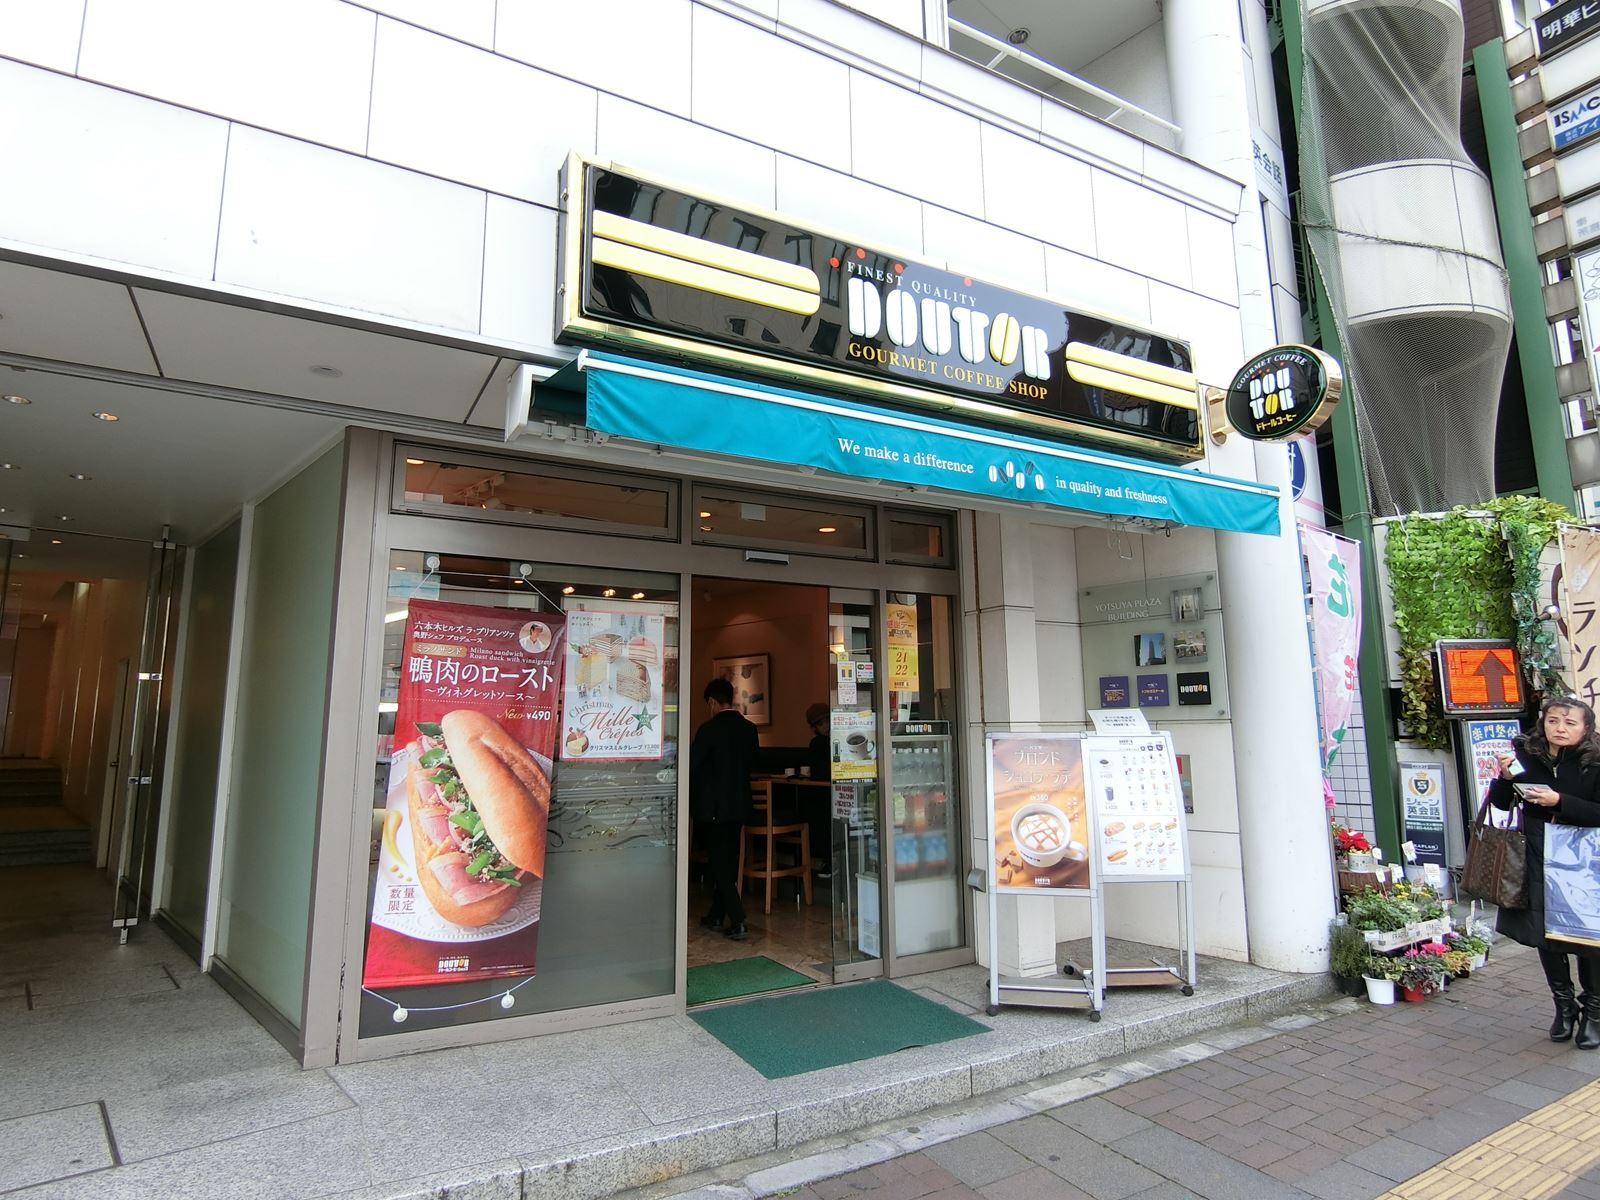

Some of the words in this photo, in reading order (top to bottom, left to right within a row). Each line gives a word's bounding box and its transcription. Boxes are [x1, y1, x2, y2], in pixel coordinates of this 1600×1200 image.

[848, 261, 904, 287] FINEST
[911, 280, 977, 307] QUALITY
[848, 277, 1051, 382] DOUTOR
[849, 342, 938, 376] GOURMET
[943, 364, 1005, 391] COFFEE
[1009, 379, 1048, 400] SHOP
[1236, 357, 1272, 390] GOURMET
[1273, 353, 1308, 366] COFFEE
[1255, 413, 1297, 432] ドトールコーヒー
[838, 437, 861, 456] We
[864, 446, 899, 462] make
[903, 452, 911, 464] a
[913, 452, 974, 475] difference
[1055, 475, 1067, 489] in
[1069, 480, 1102, 498] quality
[1104, 486, 1122, 500] and
[1125, 488, 1168, 505] freshness
[1095, 600, 1134, 613] YOTSUYA
[1134, 597, 1162, 609] PLAZA
[1107, 609, 1150, 621] BUILDING
[414, 620, 464, 633] 六本木ヒルズ
[446, 633, 483, 644] プロデュース
[469, 652, 489, 661] Roast
[489, 654, 504, 662] duck
[470, 646, 494, 655] Milano
[494, 648, 524, 657] sandwich
[896, 651, 907, 663] 21
[1450, 651, 1468, 675] 4F
[408, 655, 554, 692] 鴨肉のロースト
[895, 664, 908, 676] 22
[1180, 684, 1208, 693] DOUTOR
[496, 708, 525, 720] New
[526, 710, 551, 721] ¥490
[568, 700, 614, 718] Christmas
[579, 706, 634, 731] Mille
[905, 723, 932, 733] DOUTOR
[1406, 798, 1440, 807] シェーン
[1407, 805, 1440, 816] 英会話
[389, 887, 415, 899] 数量
[388, 899, 414, 912] 限定
